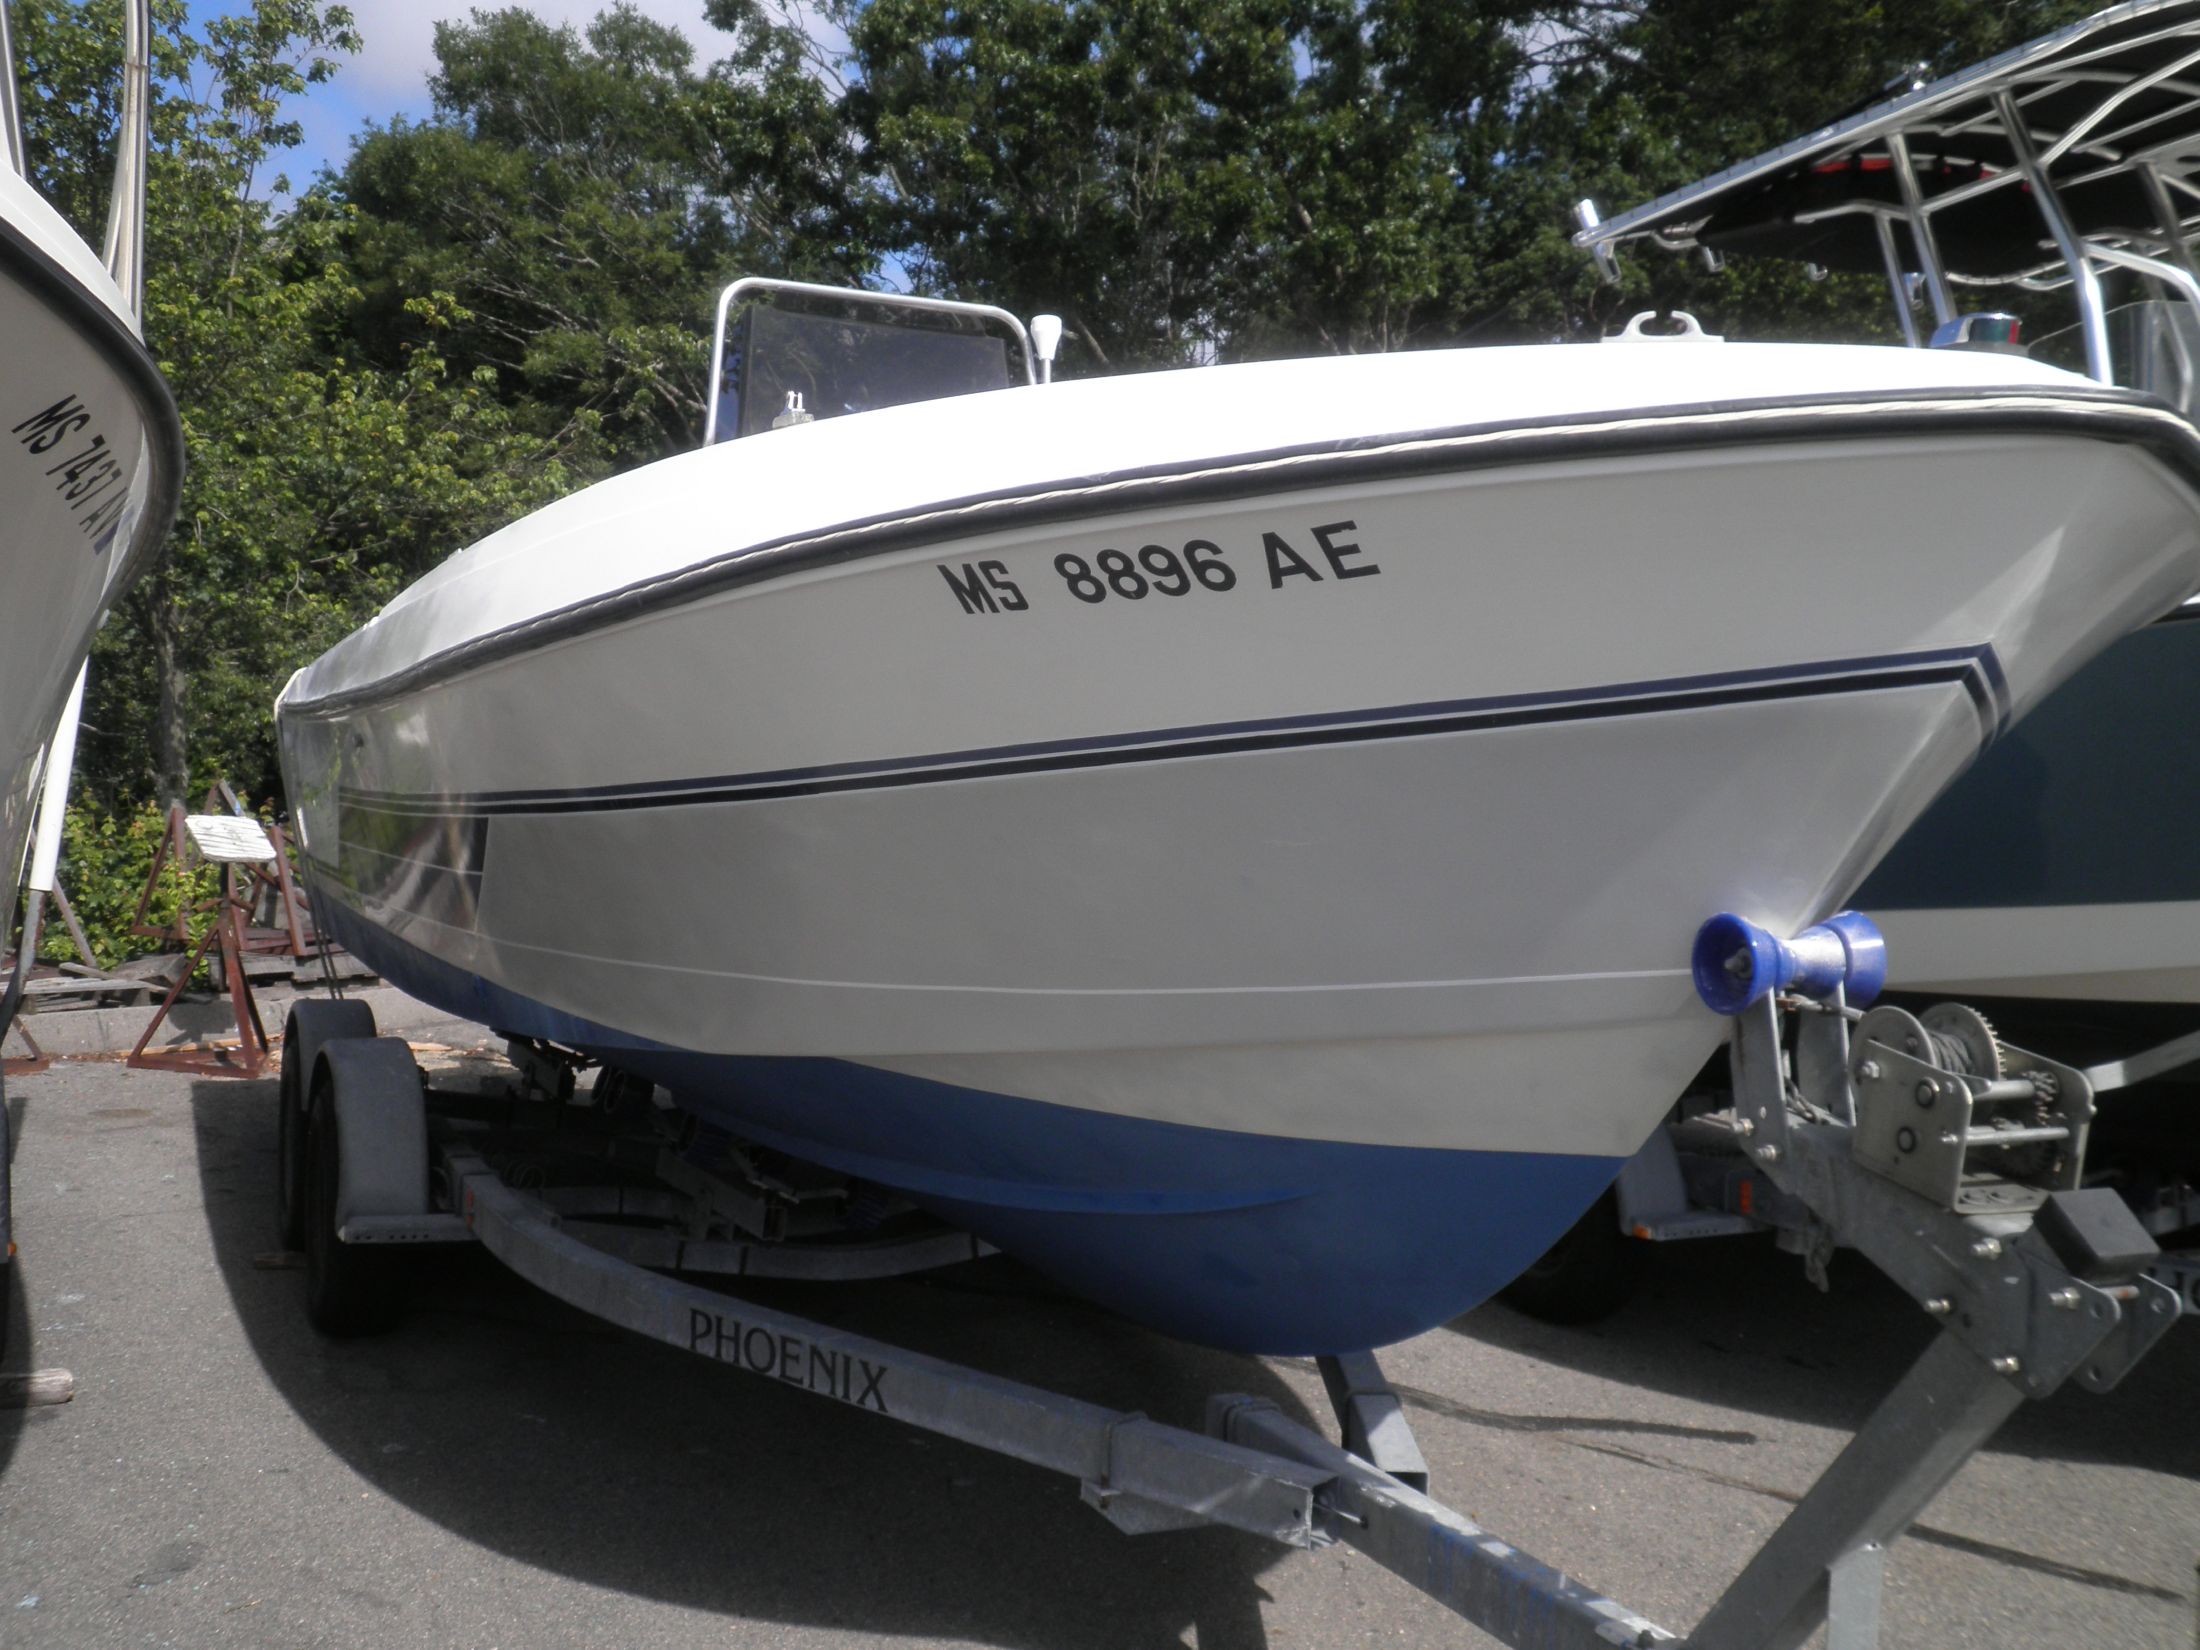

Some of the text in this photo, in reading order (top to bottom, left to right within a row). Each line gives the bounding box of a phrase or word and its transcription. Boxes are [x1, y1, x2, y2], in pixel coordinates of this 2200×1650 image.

[11, 393, 91, 454] MS
[45, 434, 122, 510] 7437
[936, 520, 1381, 614] MS 8896 AE
[689, 1308, 888, 1413] PHOENIX
